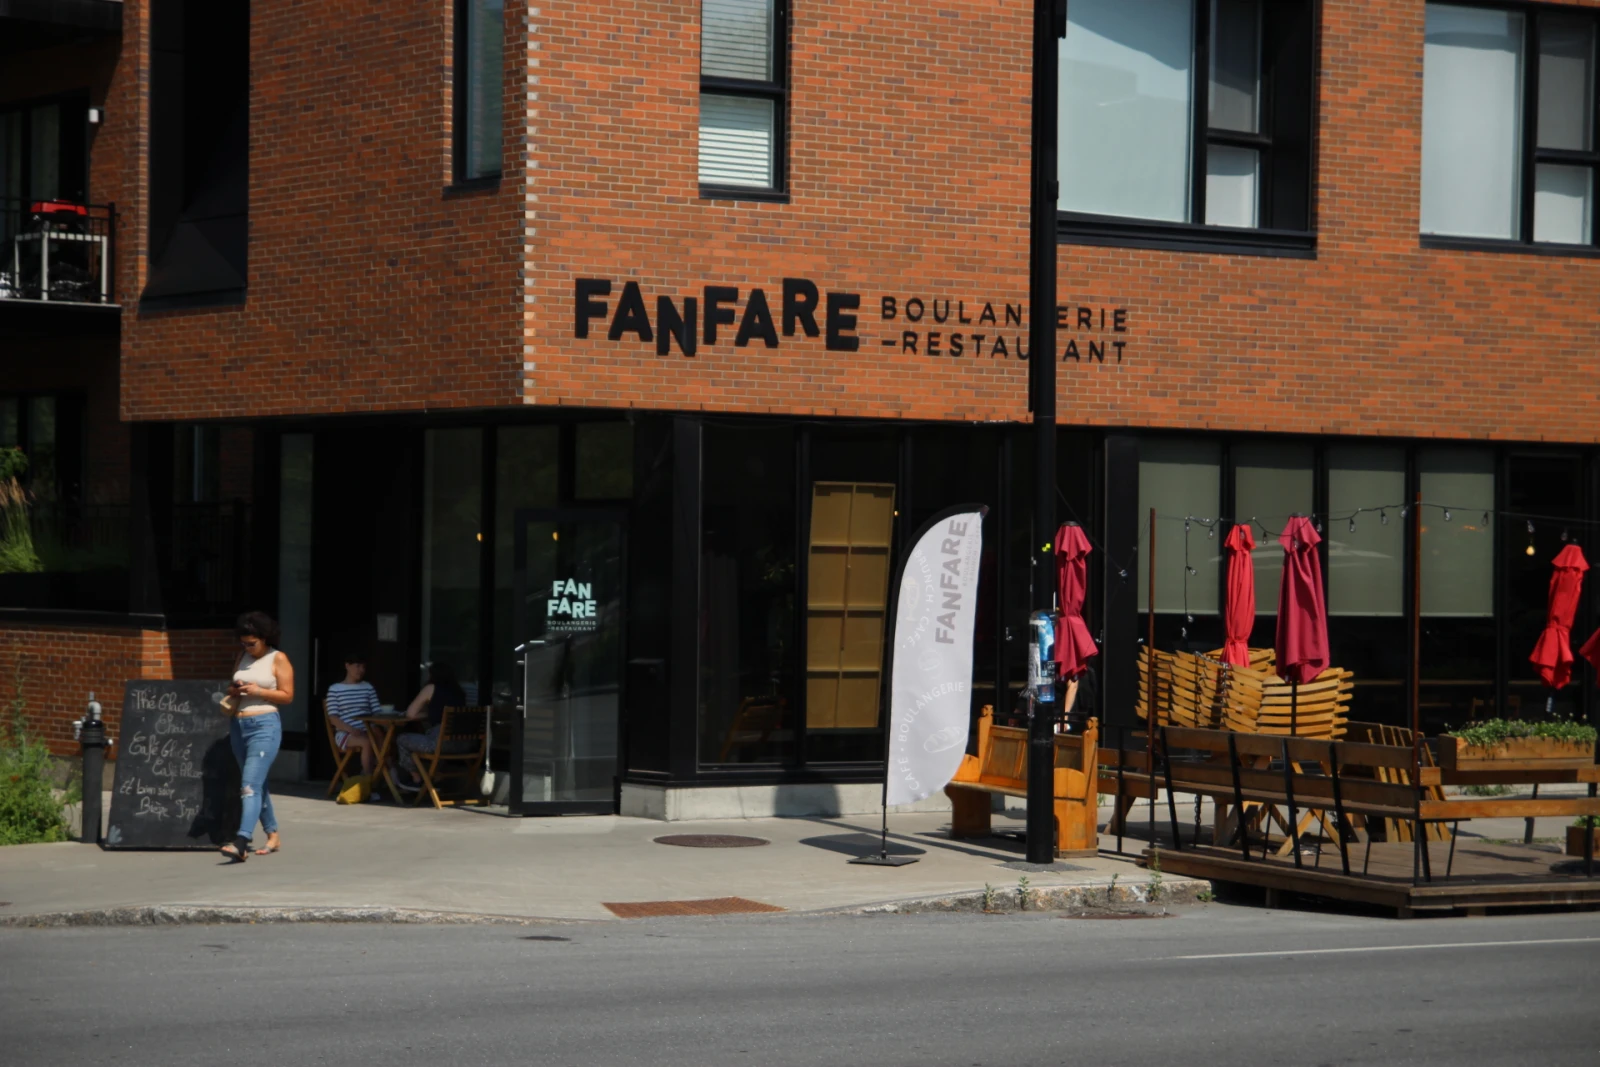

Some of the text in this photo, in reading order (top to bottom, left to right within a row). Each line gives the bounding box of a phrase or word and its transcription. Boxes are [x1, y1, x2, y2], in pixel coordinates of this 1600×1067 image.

[575, 278, 860, 357] FANFARE
[881, 296, 1127, 332] BOULANERIE
[881, 331, 1127, 364] -RESTAUANT
[553, 578, 591, 599] FAN
[935, 519, 968, 644] FANFARE
[547, 597, 597, 618] FARE
[897, 681, 965, 742] BOULANGERIE
